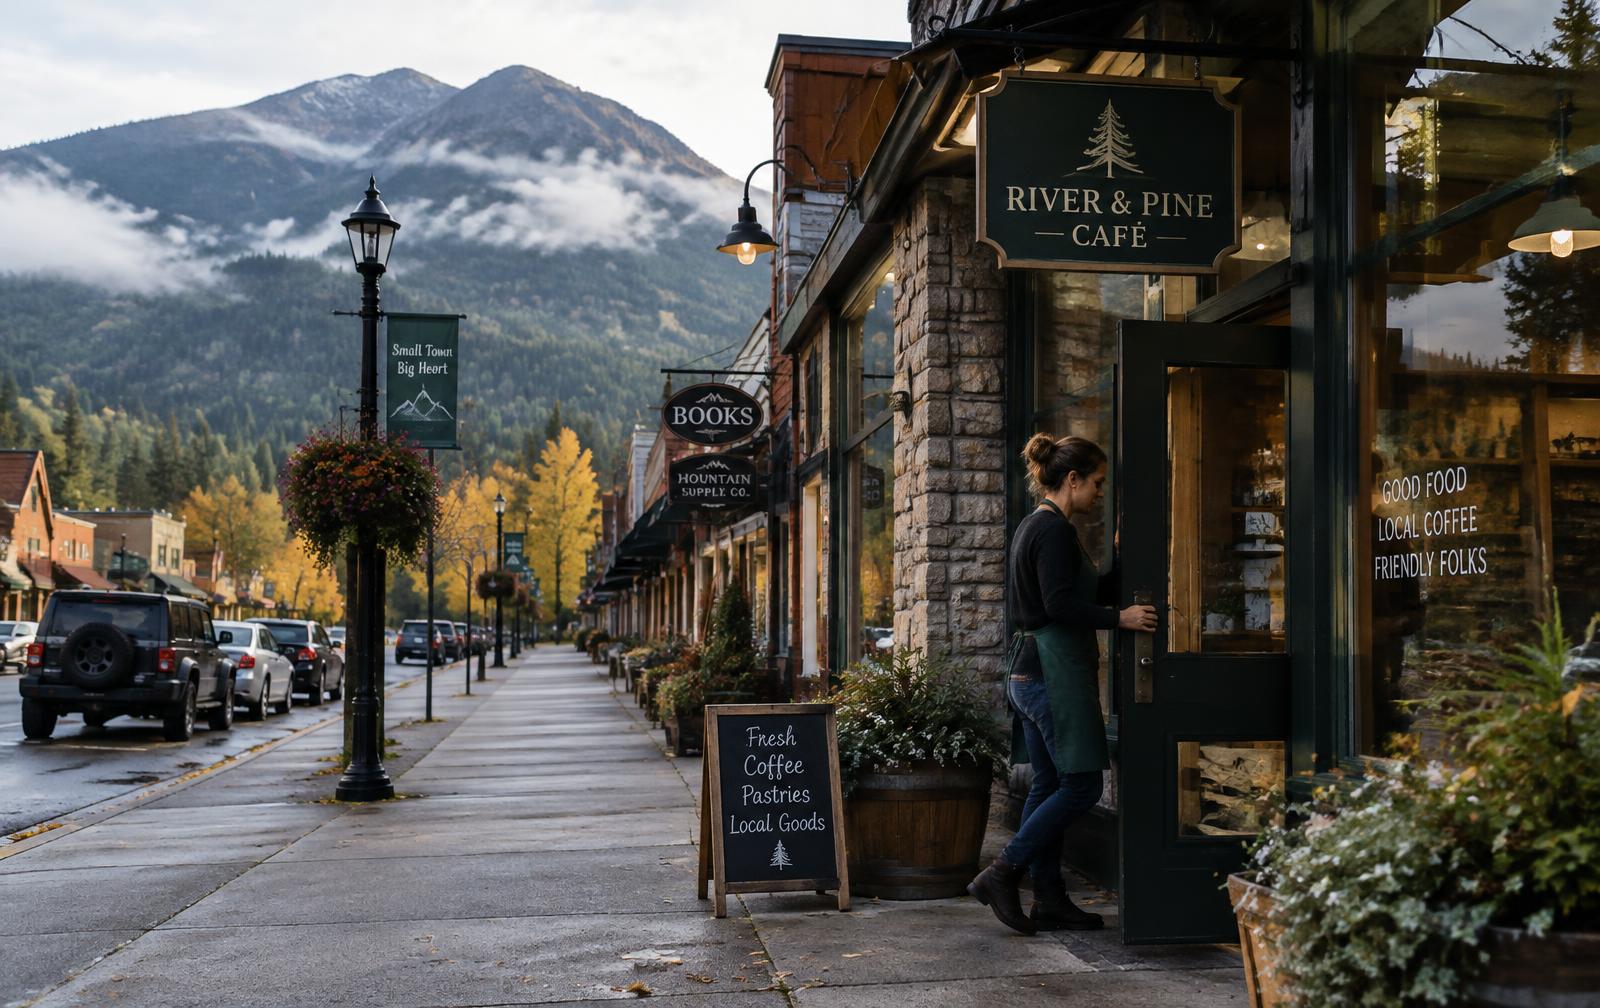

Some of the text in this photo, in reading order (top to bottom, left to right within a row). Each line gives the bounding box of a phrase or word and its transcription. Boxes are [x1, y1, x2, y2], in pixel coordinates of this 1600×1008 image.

[1006, 186, 1213, 218] RIVER & PINE
[391, 343, 453, 357] Small Town
[397, 361, 415, 378] Big
[672, 406, 754, 426] BOOKS
[681, 487, 751, 497] SUPPLY CO.
[1382, 466, 1467, 505] GOOD FOOD
[1378, 505, 1478, 542] LOCAL COFFEE
[1374, 546, 1487, 580] FRIENDLY FOLKS
[745, 724, 797, 748] Fresh
[744, 753, 805, 780] Coffee
[741, 784, 811, 806] Pastries
[729, 811, 826, 835] Local Goods
